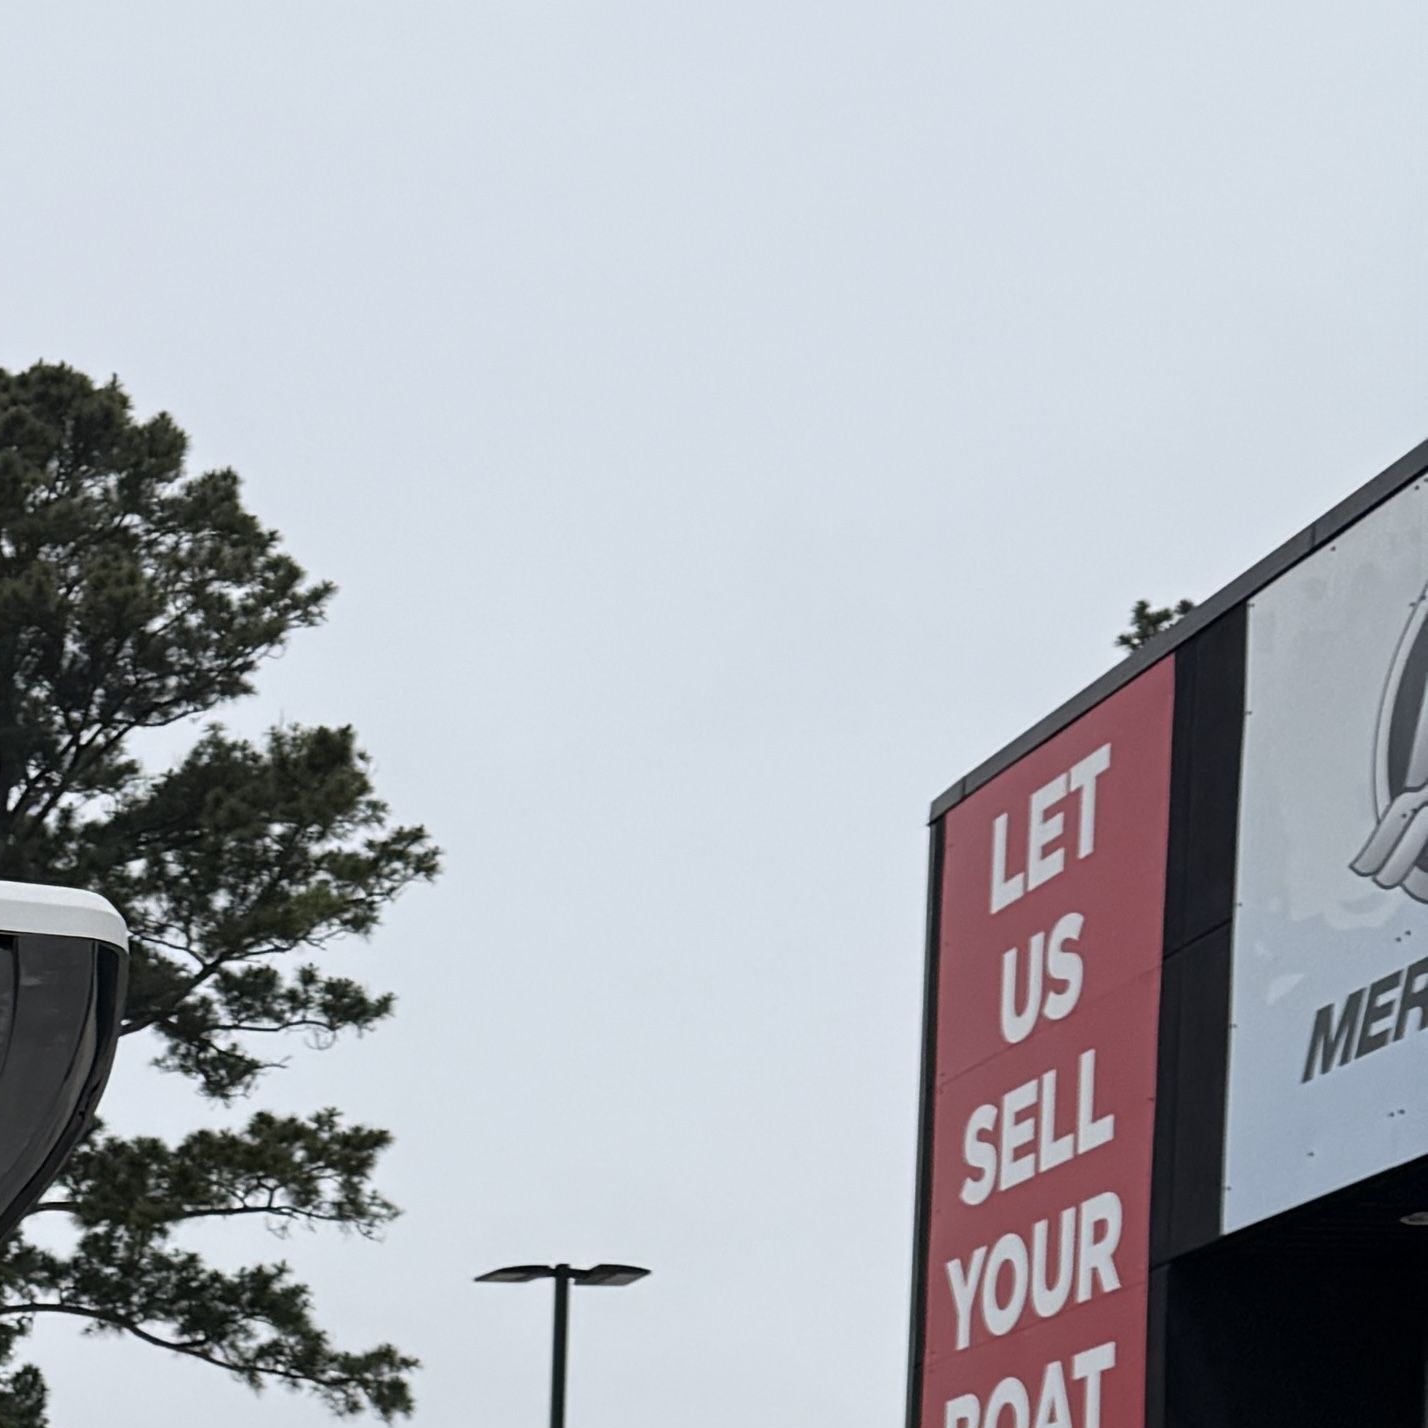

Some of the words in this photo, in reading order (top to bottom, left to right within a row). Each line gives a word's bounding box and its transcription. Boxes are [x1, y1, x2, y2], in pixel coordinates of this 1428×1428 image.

[990, 743, 1111, 915] LET
[1000, 912, 1084, 1043] US
[961, 1049, 1115, 1206] SELL
[947, 1192, 1123, 1351] YOUR
